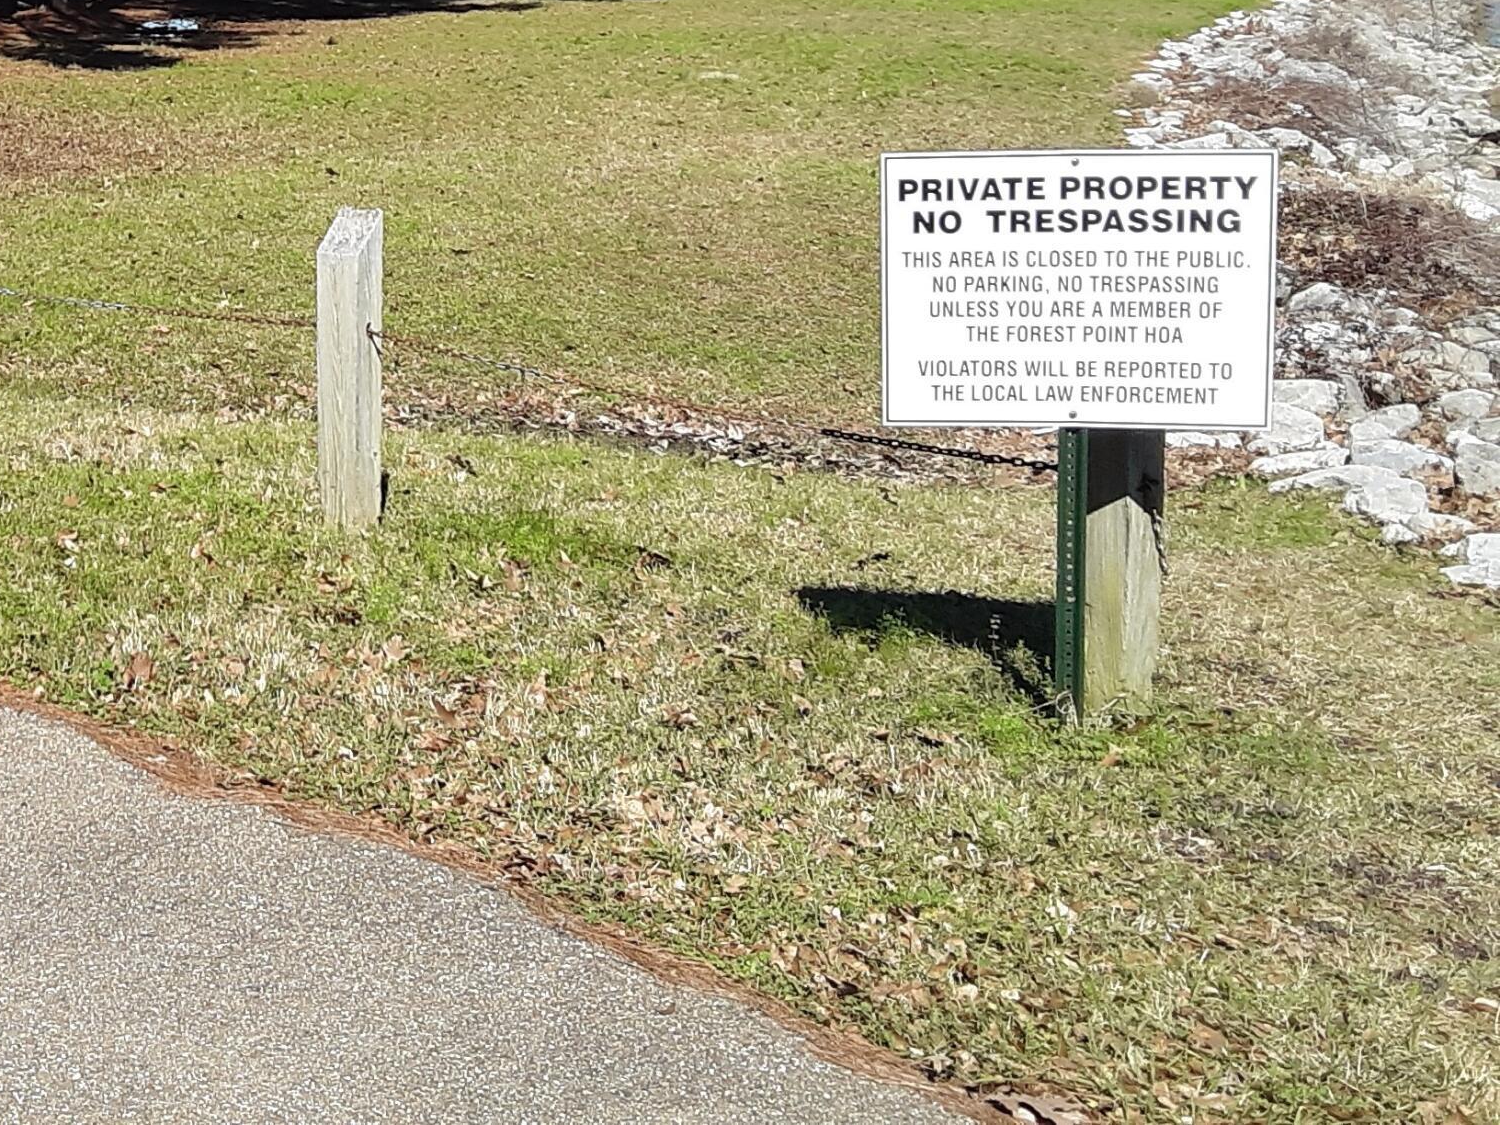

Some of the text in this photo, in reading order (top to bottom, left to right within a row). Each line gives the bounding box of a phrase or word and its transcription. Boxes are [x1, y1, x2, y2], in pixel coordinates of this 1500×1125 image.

[898, 176, 1258, 202] PRIVATE PROPERTY
[912, 209, 1242, 234] NO TRESPASSING
[902, 250, 1252, 269] THIS AREA IS CLOSED TO THE PUBLIC.
[932, 276, 1220, 296] NO PARKING, NO TRESPASSING
[929, 301, 1224, 318] UNLESS YOU ARE A MEMBER OF
[966, 326, 1184, 344] THE FOREST POINT HOA
[918, 360, 1233, 380] VIOLATORS WILL BE REPORTED TO
[931, 385, 1219, 405] THE LOCAL LAW ENFORCEMENT
